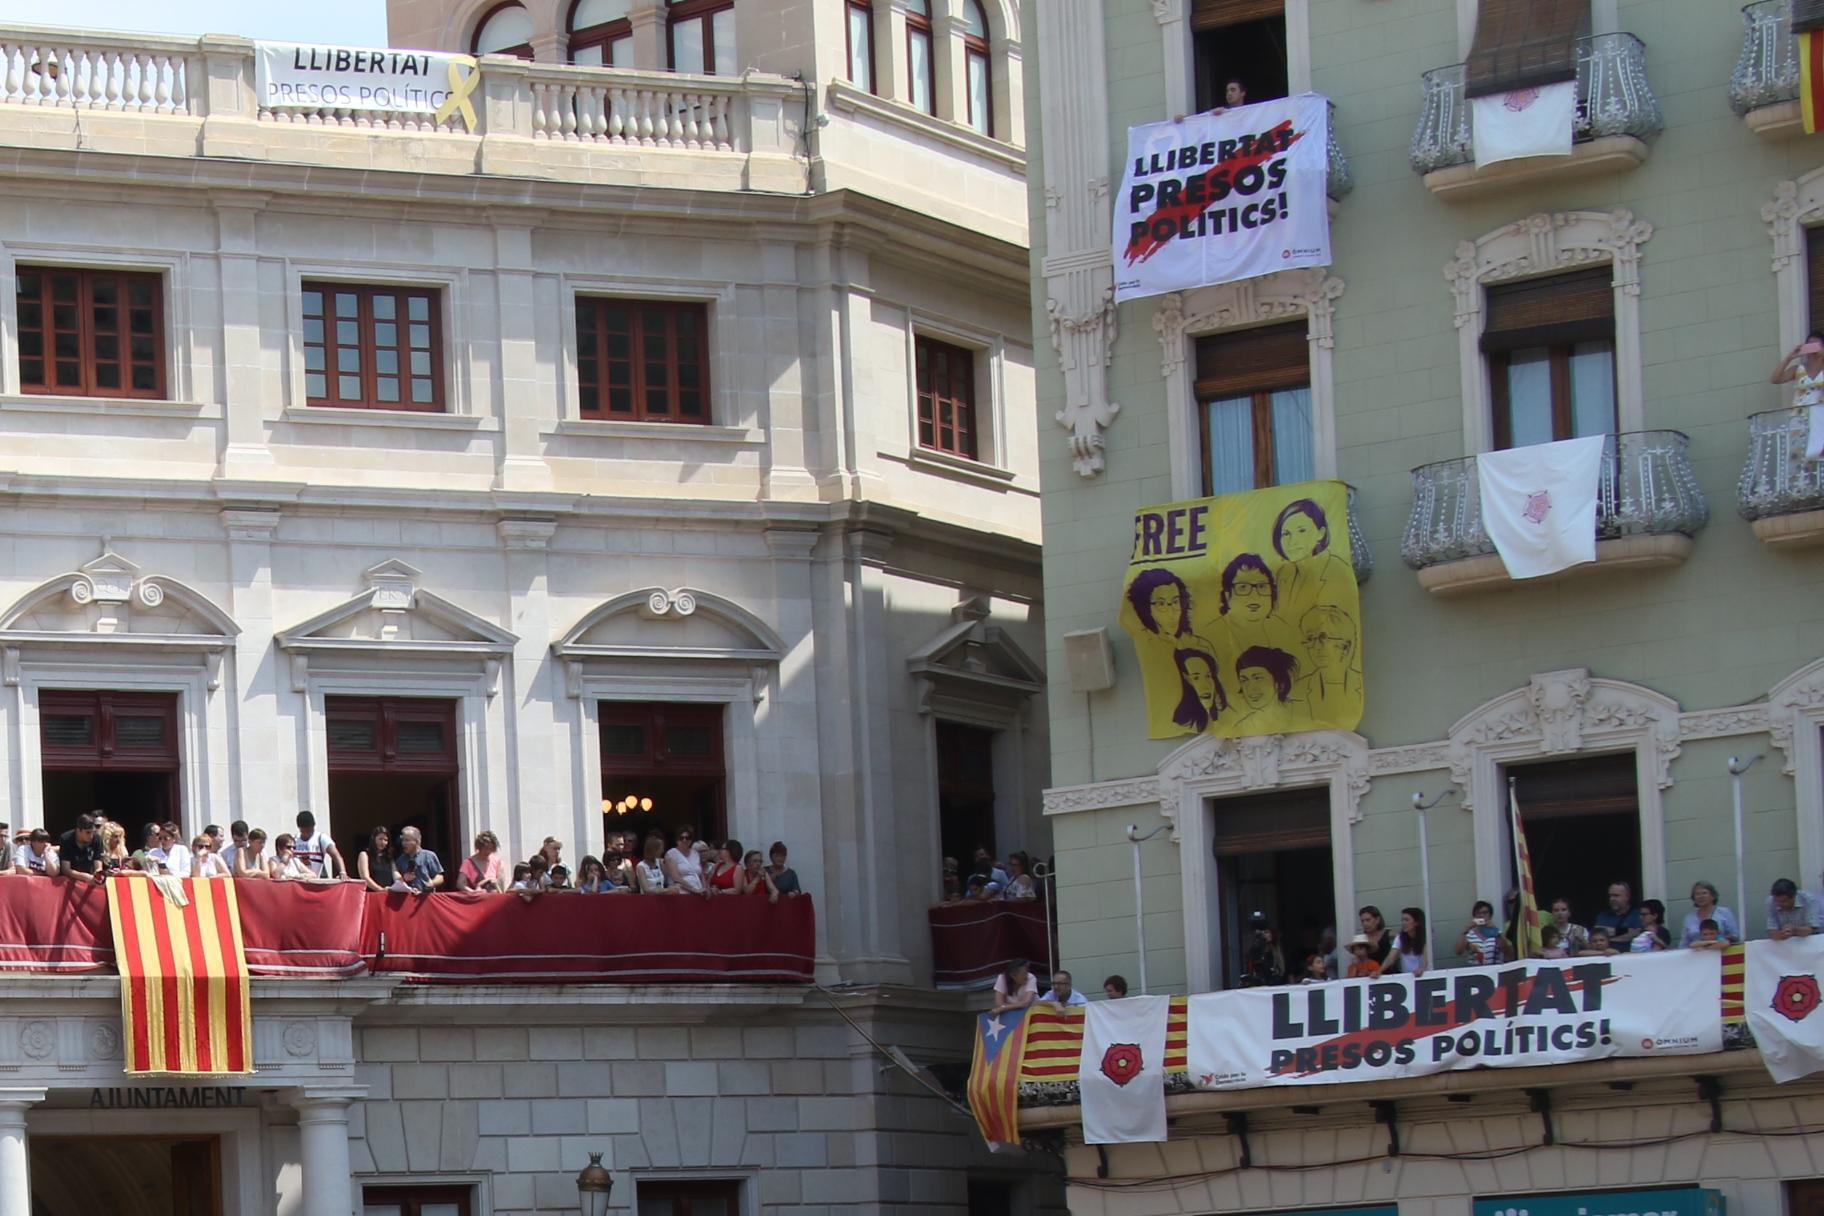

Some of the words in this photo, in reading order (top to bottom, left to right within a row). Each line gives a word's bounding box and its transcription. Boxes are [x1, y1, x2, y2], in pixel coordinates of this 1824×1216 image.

[293, 46, 433, 76] LLIBERTAT
[269, 82, 351, 105] PRESOS
[1133, 127, 1294, 178] LLIBERTAT
[1130, 157, 1288, 214] PRESOS
[1131, 505, 1208, 560] FREE
[1272, 962, 1612, 1040] LLIBERTAT
[1270, 1038, 1416, 1074] PRESOS
[1432, 1018, 1612, 1062] POLÍTICS!
[90, 1086, 246, 1109] AJUNTAMENT
